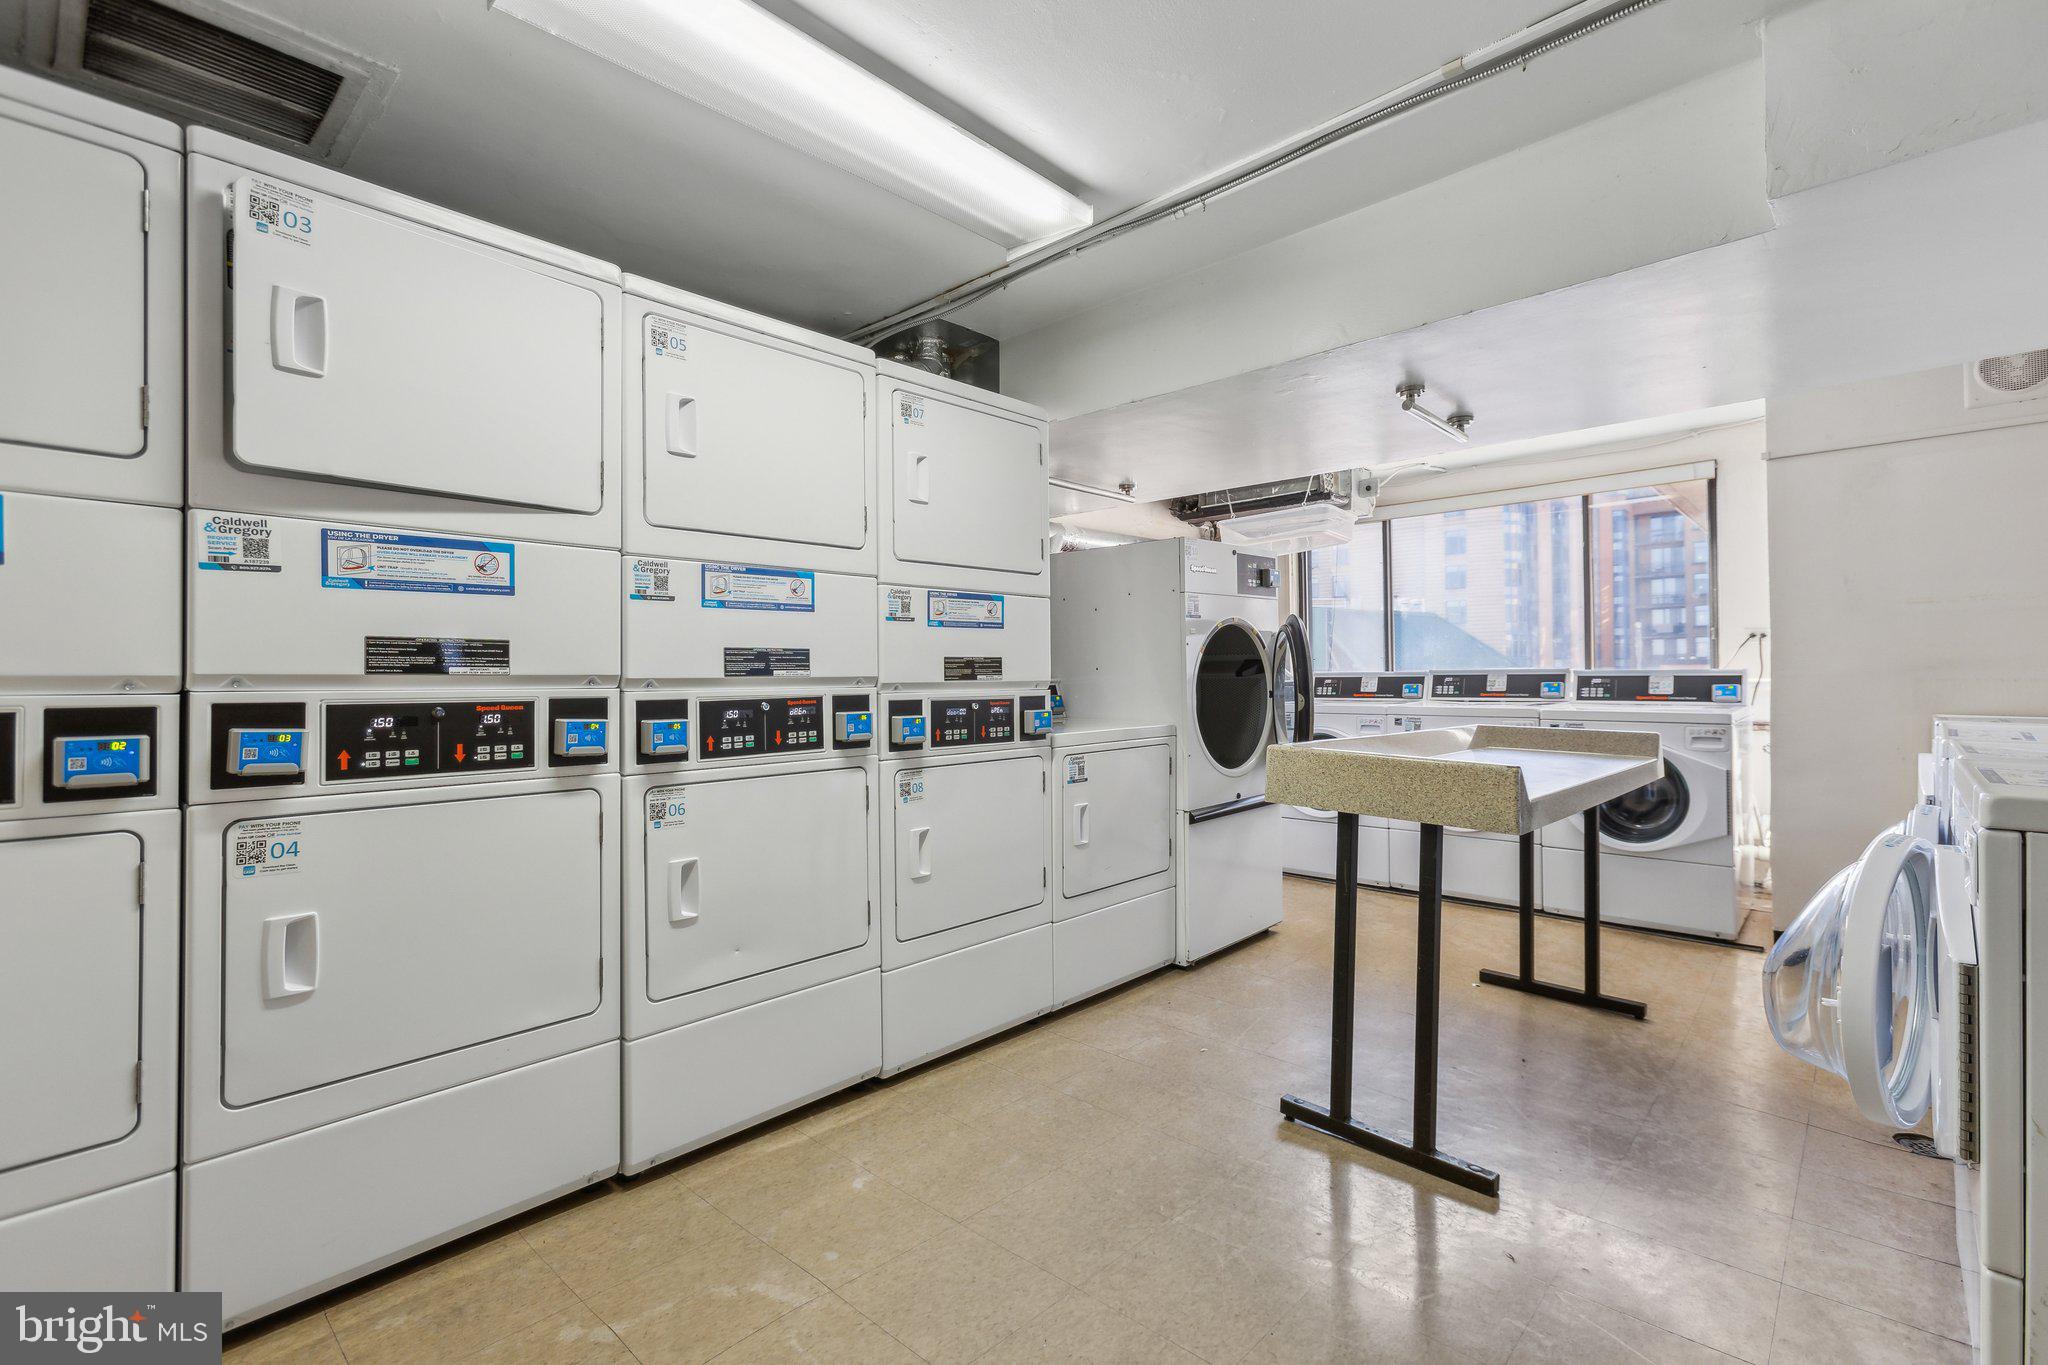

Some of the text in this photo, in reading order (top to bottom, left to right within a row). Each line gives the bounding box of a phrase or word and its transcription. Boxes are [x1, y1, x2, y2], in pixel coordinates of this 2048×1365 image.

[283, 211, 312, 234] 03
[670, 337, 686, 351] 05
[913, 407, 924, 419] 07
[212, 516, 268, 528] Caldwell
[204, 522, 272, 538] & Gregory
[638, 560, 668, 568] Caldwell
[641, 566, 671, 575] Gregory
[279, 734, 291, 742] 03
[112, 741, 126, 750] 02
[912, 782, 924, 793] 08
[669, 803, 685, 816] 06
[271, 841, 300, 859] 04
